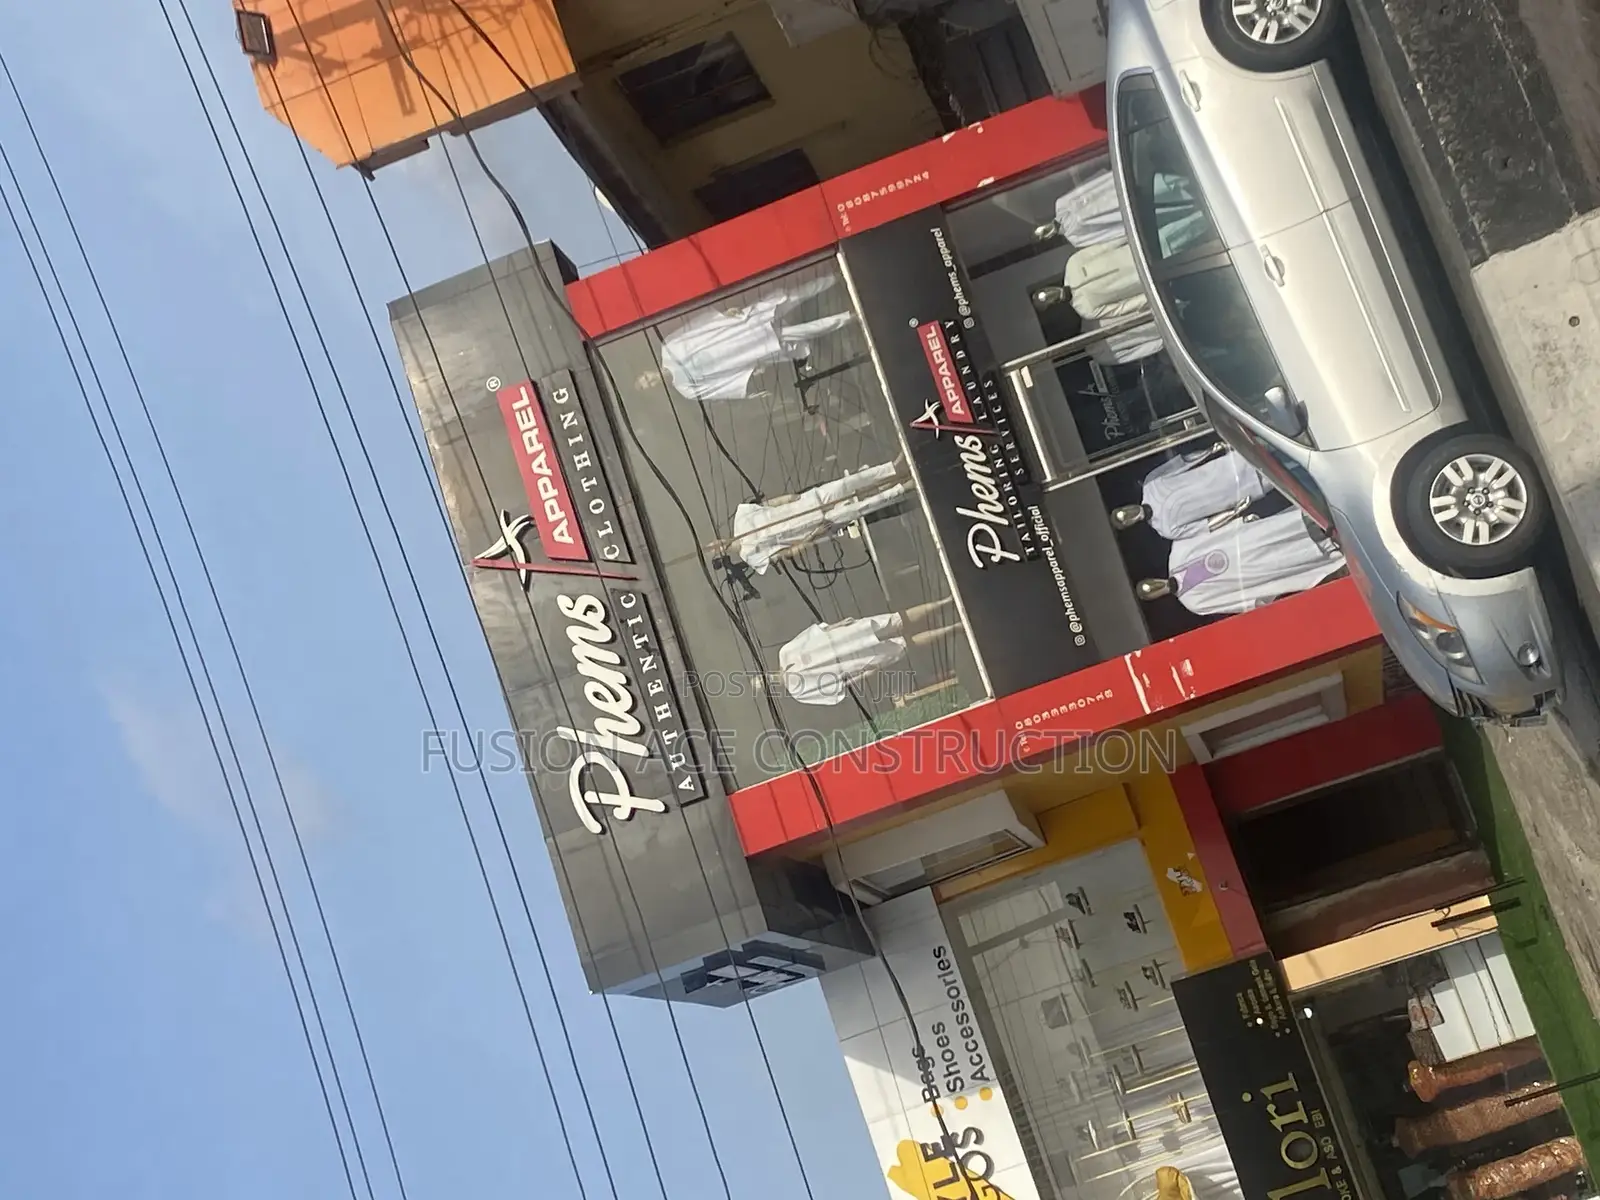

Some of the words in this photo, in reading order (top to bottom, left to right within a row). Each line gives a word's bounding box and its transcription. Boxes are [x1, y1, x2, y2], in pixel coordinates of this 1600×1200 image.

[926, 325, 965, 415] APPAREL
[945, 320, 987, 422] LAUNDRY
[983, 379, 1025, 477] SERVICES
[513, 386, 575, 545] APPAREL
[553, 387, 620, 561] CLOTHING
[954, 434, 1021, 569] Phems
[989, 443, 1035, 556] TAILORING
[1027, 505, 1084, 637] @phemsapparel_official
[556, 594, 668, 835] Phems
[620, 591, 695, 792] AUTHENTIC
[932, 945, 991, 1082] Accessories
[932, 1021, 965, 1093] Shoes
[1310, 1108, 1326, 1129] EBI
